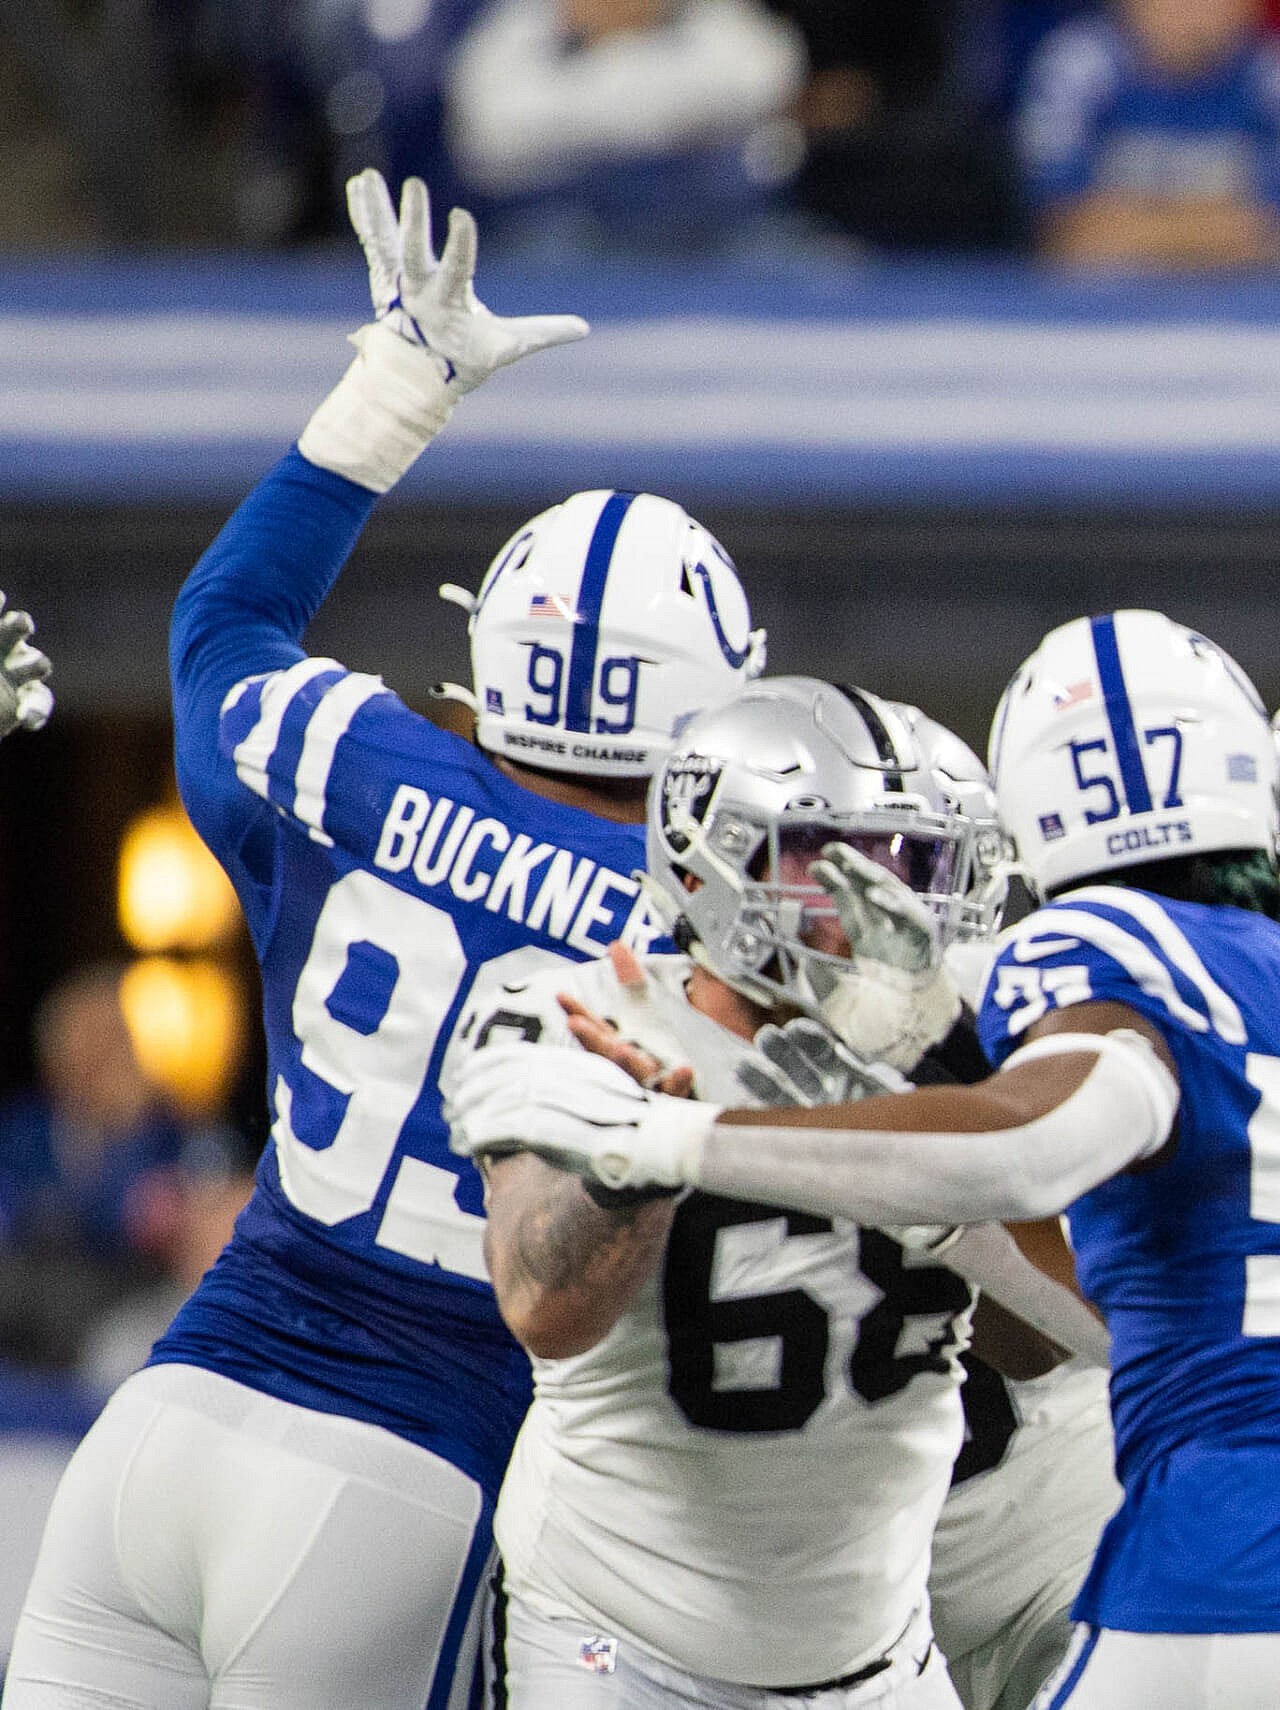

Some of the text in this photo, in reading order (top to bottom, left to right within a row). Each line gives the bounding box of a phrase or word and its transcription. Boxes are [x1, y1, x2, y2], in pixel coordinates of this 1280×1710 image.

[525, 643, 639, 734] 99
[504, 731, 650, 762] INSPIRE CHANGE
[1069, 726, 1184, 826] 57
[1106, 820, 1193, 855] COLTS
